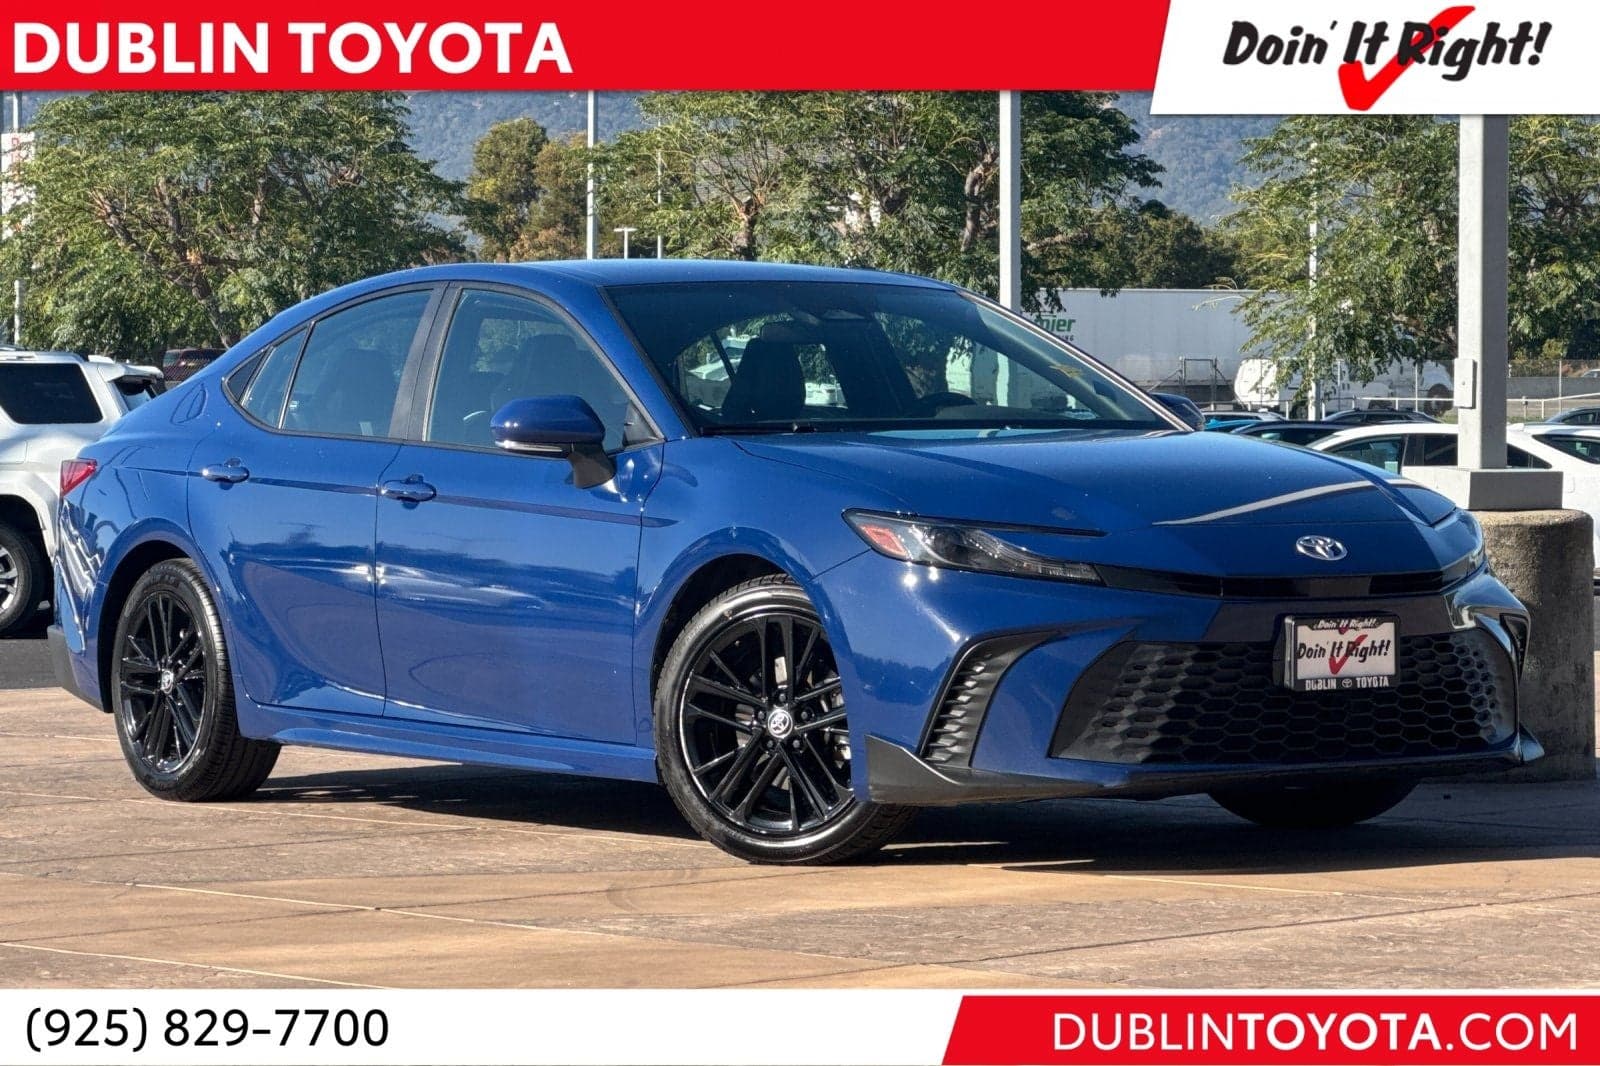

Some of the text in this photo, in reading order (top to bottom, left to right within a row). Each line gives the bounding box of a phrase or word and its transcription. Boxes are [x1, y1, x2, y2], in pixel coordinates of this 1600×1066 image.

[1330, 641, 1344, 658] It
[1346, 640, 1391, 663] Right!
[1305, 676, 1389, 691] DUBLIN TOYOTA
